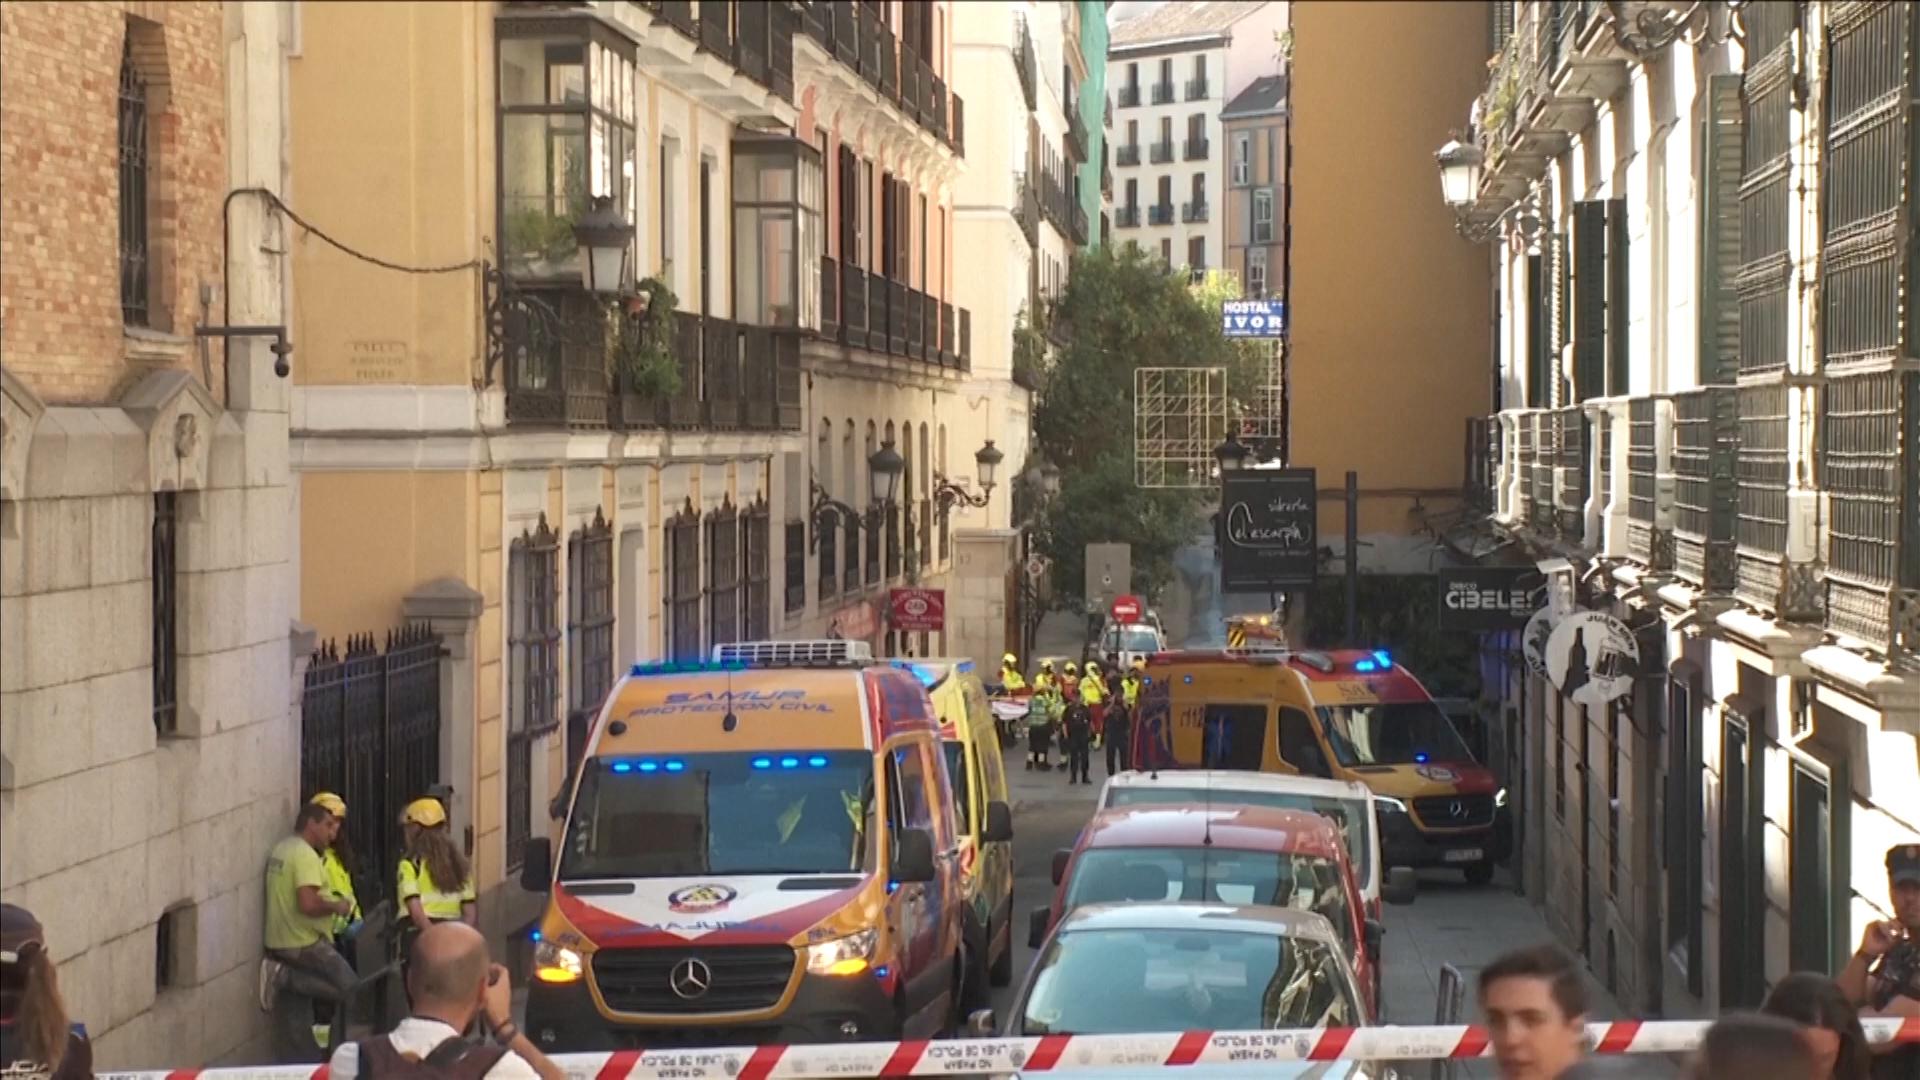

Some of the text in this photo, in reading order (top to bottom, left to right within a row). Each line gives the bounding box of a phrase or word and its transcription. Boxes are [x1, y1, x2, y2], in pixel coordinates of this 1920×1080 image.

[1223, 301, 1272, 314] HOSTAL
[1223, 315, 1283, 329] IVOR
[663, 689, 808, 705] SAMUR
[779, 701, 835, 714] CIVIL
